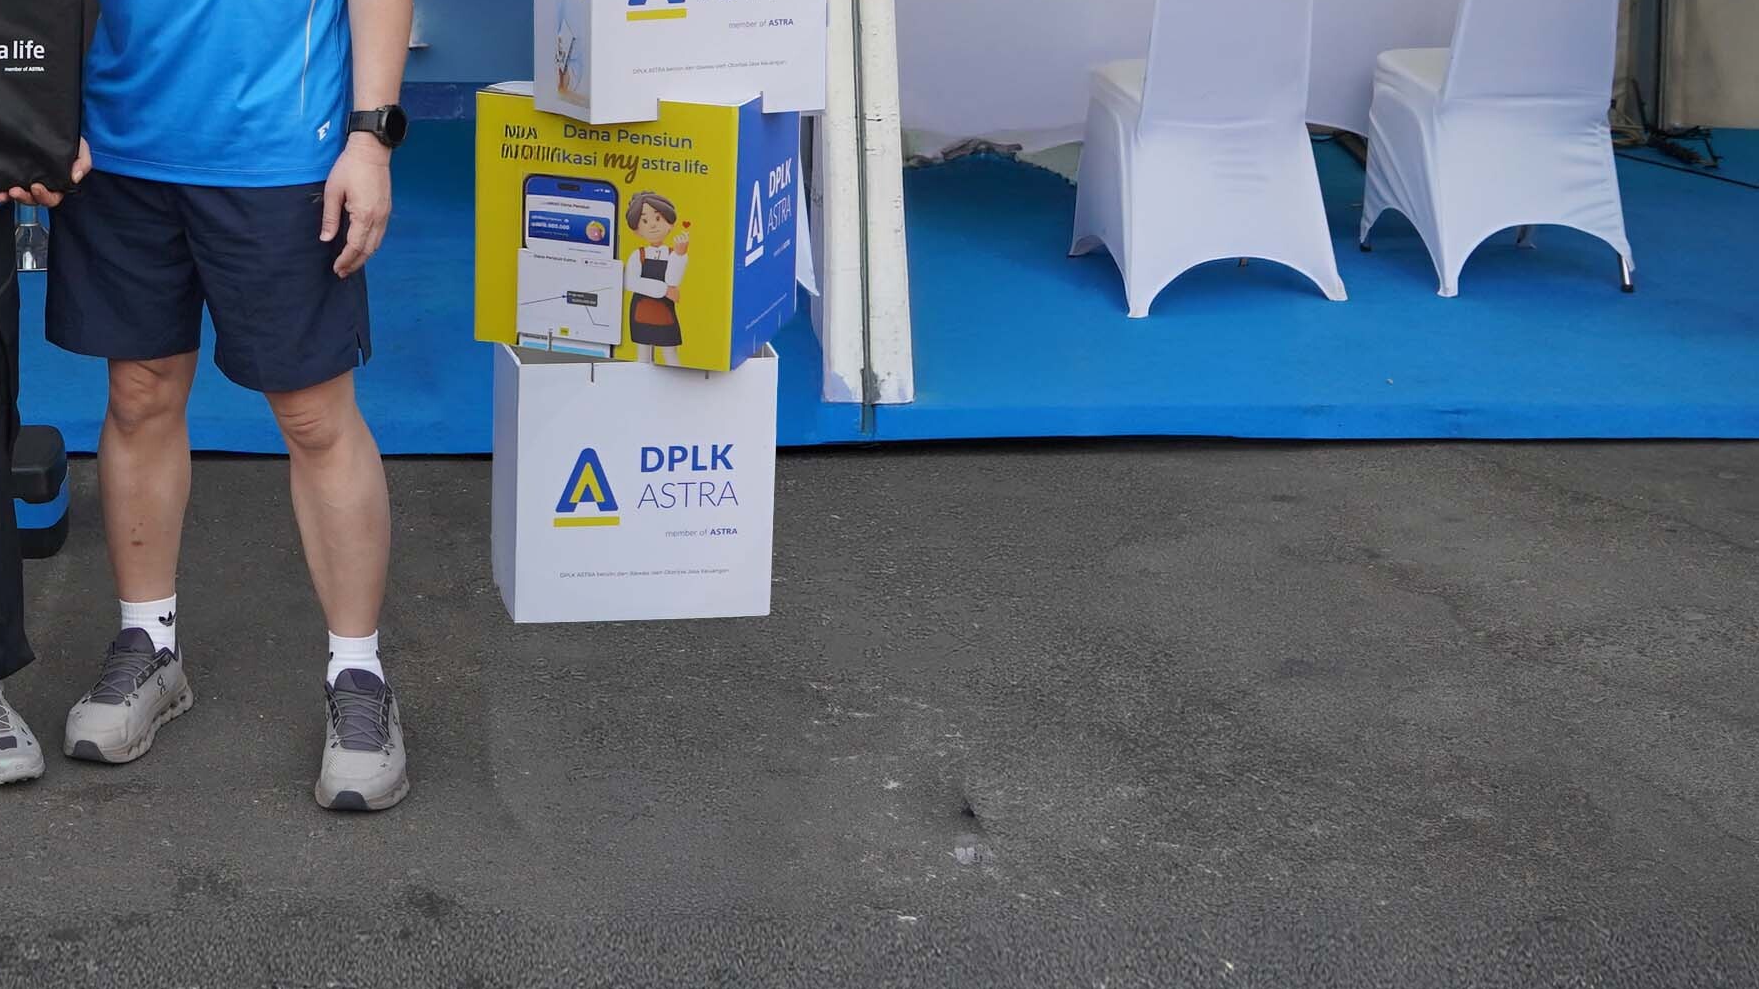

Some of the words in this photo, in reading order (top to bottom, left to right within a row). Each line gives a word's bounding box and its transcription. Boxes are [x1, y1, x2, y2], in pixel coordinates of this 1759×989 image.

[729, 21, 757, 29] member
[768, 18, 794, 27] ASTRA
[13, 40, 45, 60] life
[563, 125, 611, 142] Dana
[617, 129, 692, 149] Pensiun
[604, 152, 639, 184] my
[642, 158, 680, 172] astra
[684, 159, 709, 175] life
[769, 158, 792, 199] DPLK
[767, 195, 792, 235] ASTRA
[641, 444, 734, 473] DPLK
[637, 481, 739, 509] ASTRA
[710, 528, 738, 536] ASTRA
